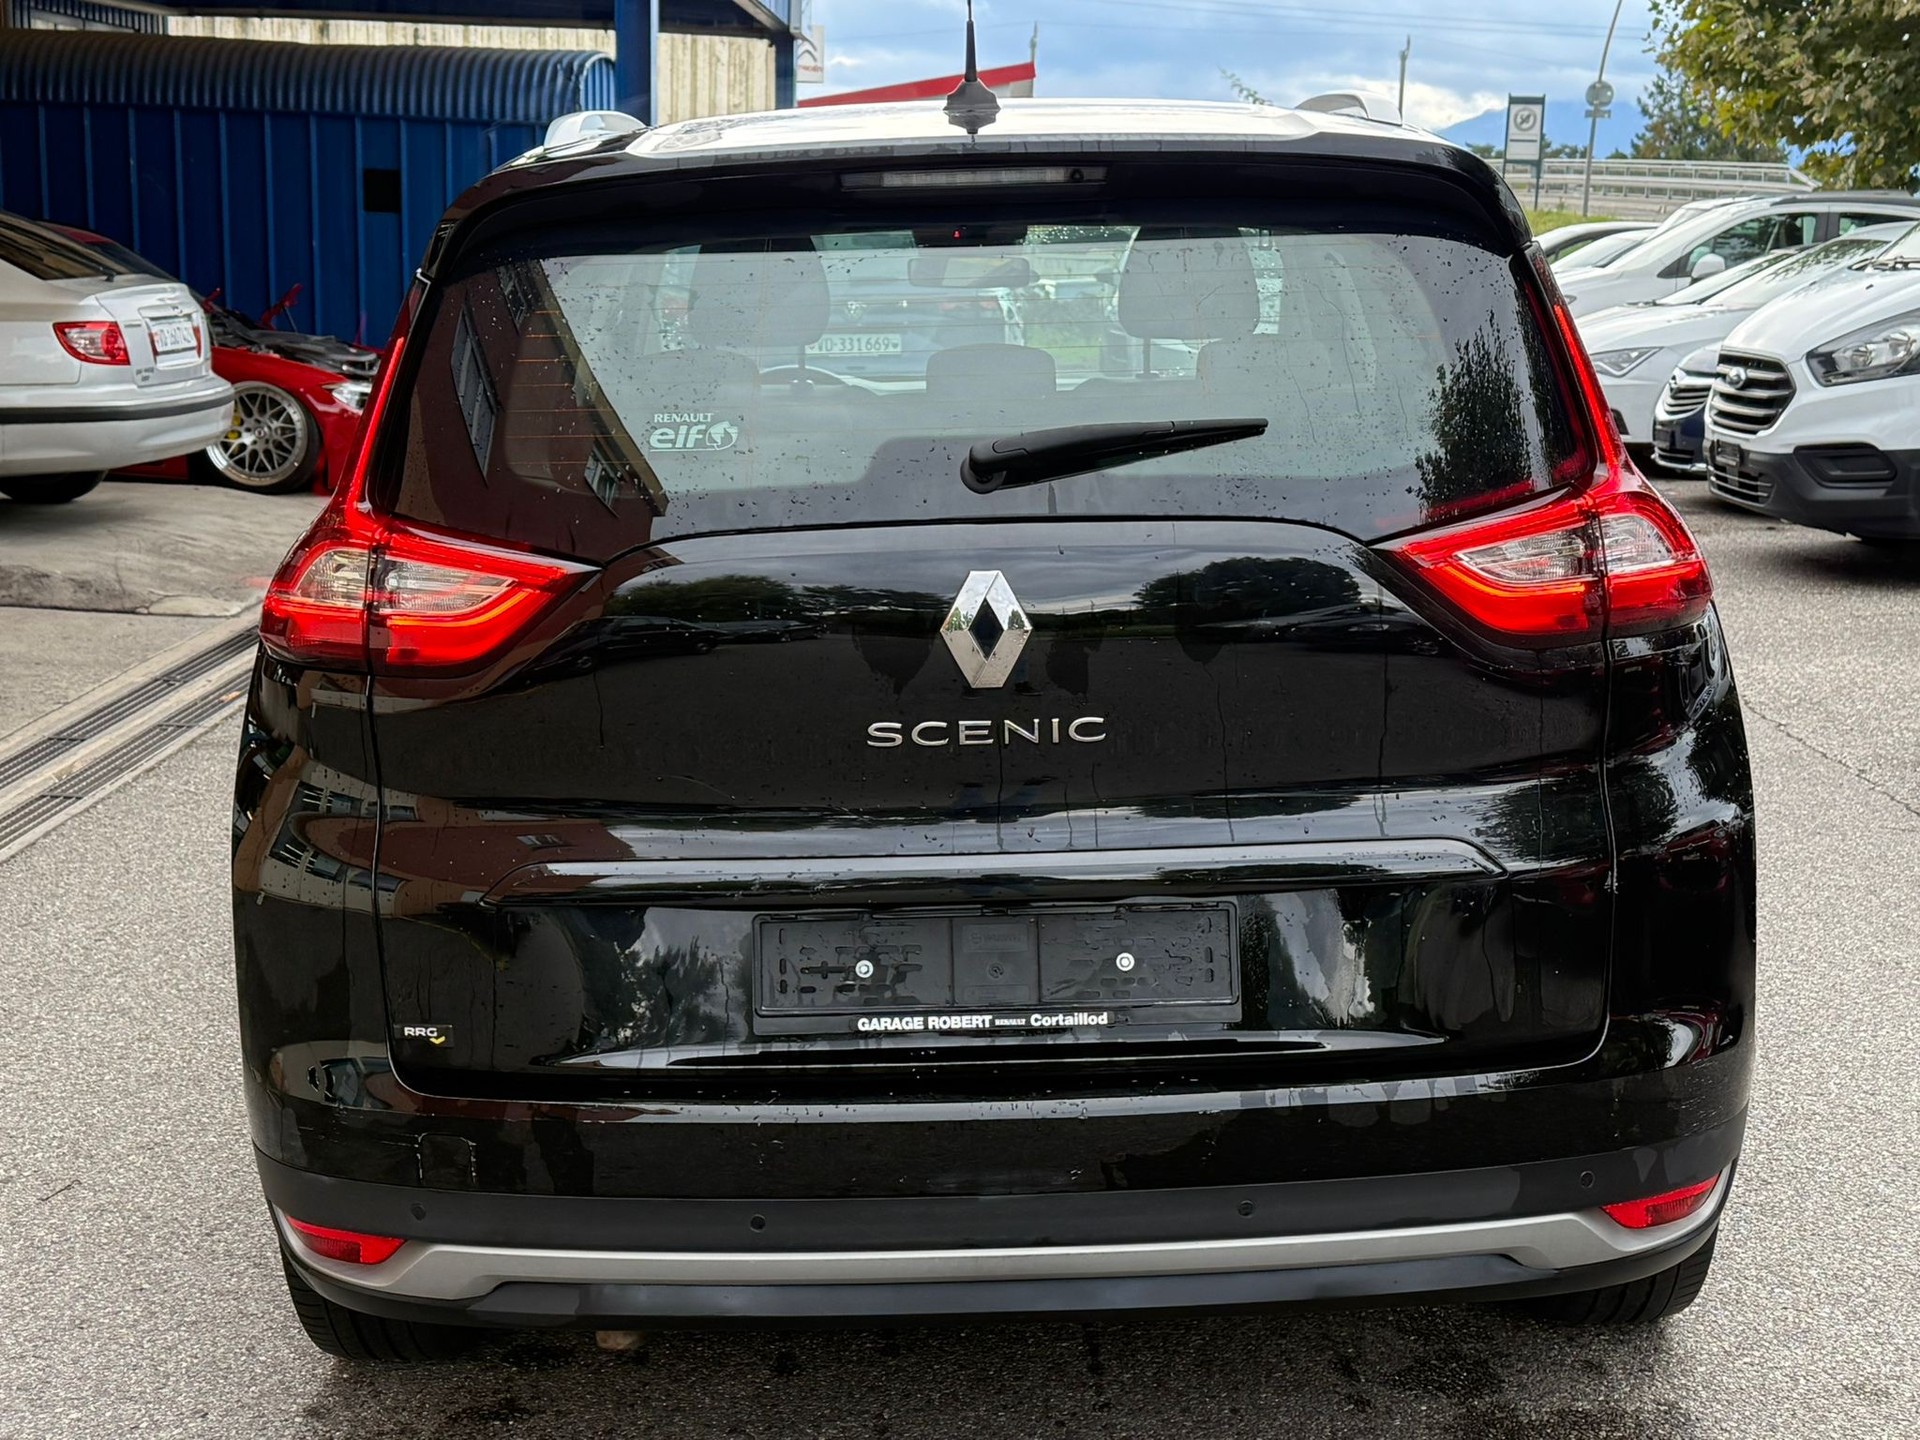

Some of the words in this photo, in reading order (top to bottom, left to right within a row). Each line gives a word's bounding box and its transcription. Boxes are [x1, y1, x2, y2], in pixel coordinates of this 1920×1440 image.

[654, 412, 715, 423] RENAULT
[649, 424, 707, 448] elf
[866, 716, 1107, 747] SCENIC
[403, 1026, 438, 1037] RRG
[857, 1016, 925, 1032] GARAGE
[927, 1014, 993, 1030] ROBERT
[1030, 1011, 1109, 1027] Cortaillod
